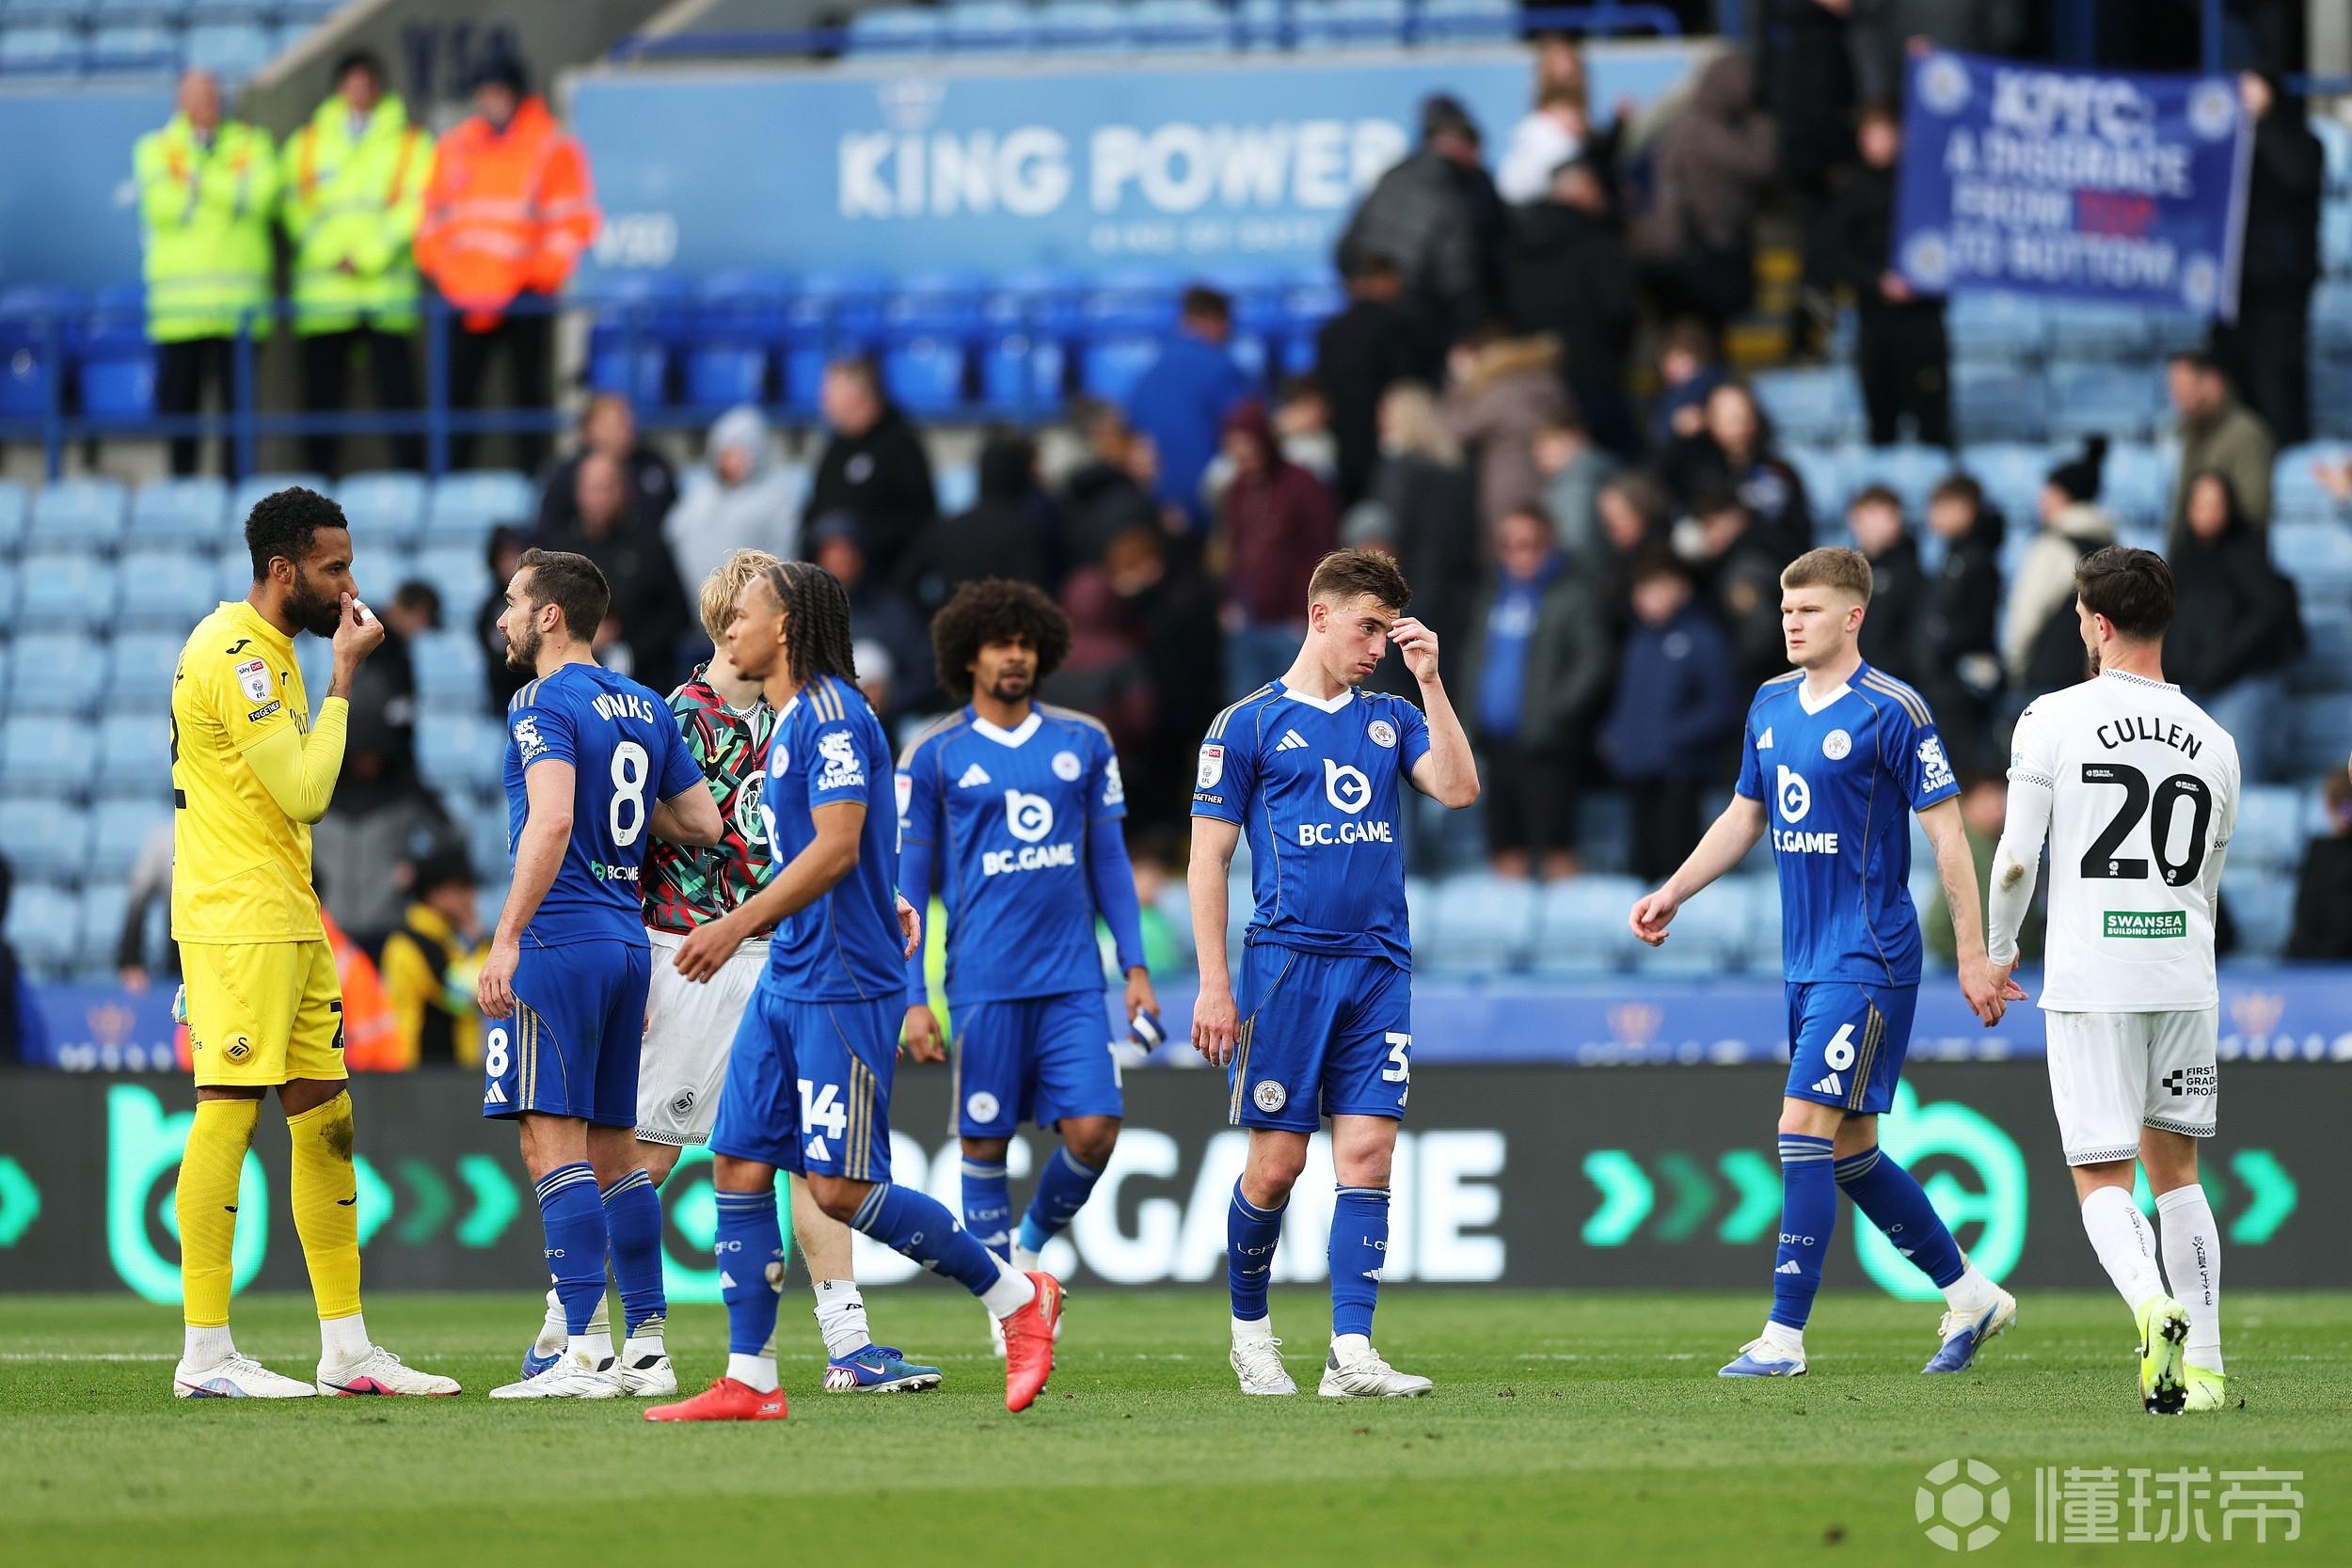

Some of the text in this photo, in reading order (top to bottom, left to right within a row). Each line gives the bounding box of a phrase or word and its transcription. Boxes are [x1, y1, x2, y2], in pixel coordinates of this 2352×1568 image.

[837, 117, 1408, 219] KING POWER
[1944, 127, 2193, 198] A DISGRACE
[1950, 175, 2070, 231] FROM
[592, 693, 654, 724] WNKS
[2097, 717, 2202, 760] CULLEN
[611, 741, 649, 847] 8
[818, 773, 865, 791] SAIGON
[1298, 820, 1393, 847] BC.GAME
[2081, 763, 2213, 887] 20
[982, 843, 1076, 877] BC.GAME
[2107, 915, 2183, 927] SWANSEA
[485, 1027, 509, 1078] 8
[1382, 1032, 1412, 1083] 3
[1824, 1022, 1855, 1071] 6
[2186, 1066, 2215, 1076] FIRST
[2185, 1076, 2217, 1085] GRAD
[797, 1078, 847, 1140] 14
